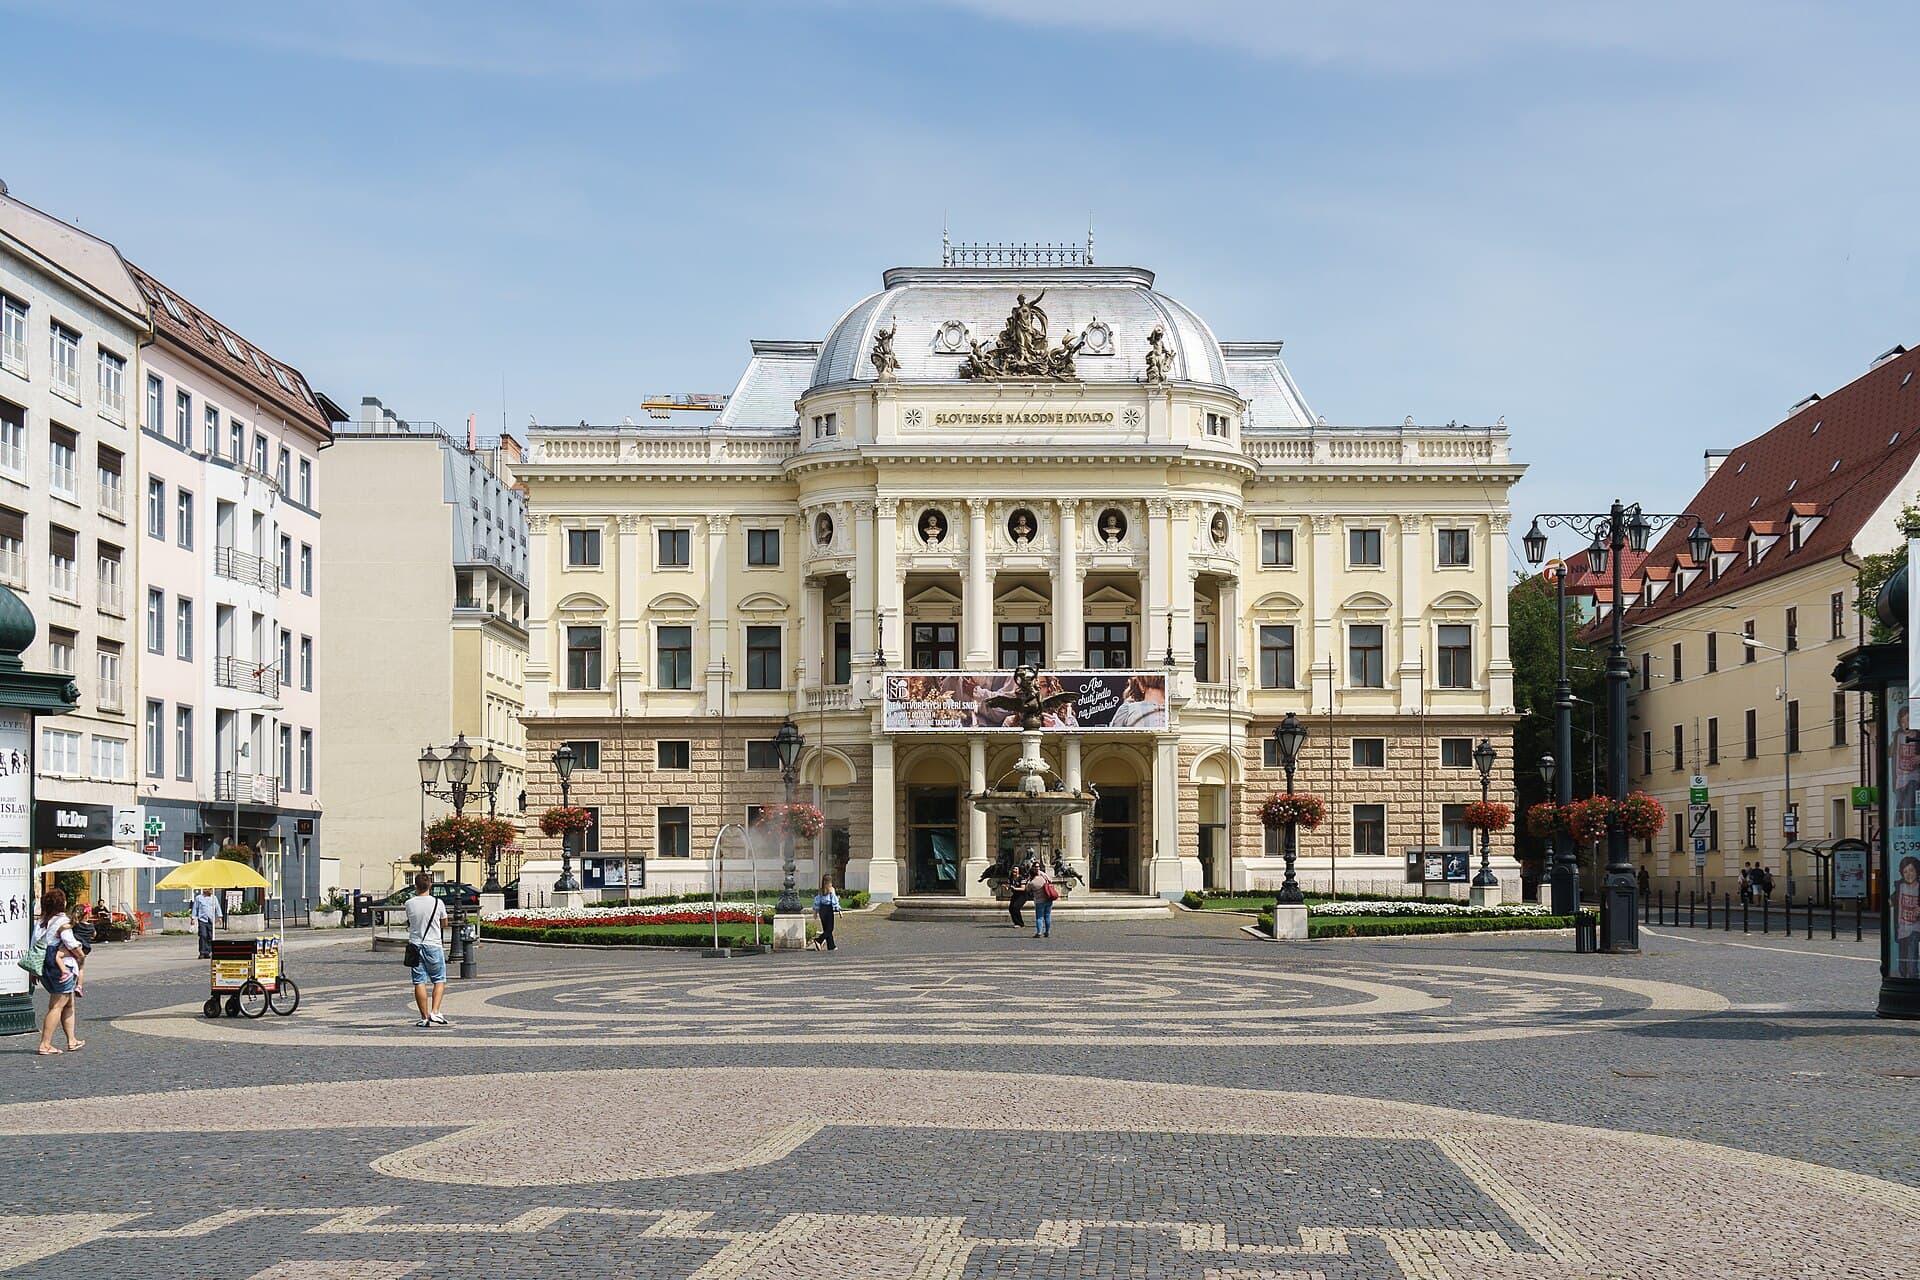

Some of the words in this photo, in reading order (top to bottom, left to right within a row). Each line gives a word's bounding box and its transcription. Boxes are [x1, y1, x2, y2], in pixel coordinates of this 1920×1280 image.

[935, 411, 1003, 424] SLOVENSKÉ
[1006, 411, 1063, 424] NÁRODNÉ
[1065, 412, 1114, 424] DIVADLO
[1080, 677, 1103, 694] Ako
[1696, 840, 1704, 849] P
[1893, 840, 1920, 855] €3.99
